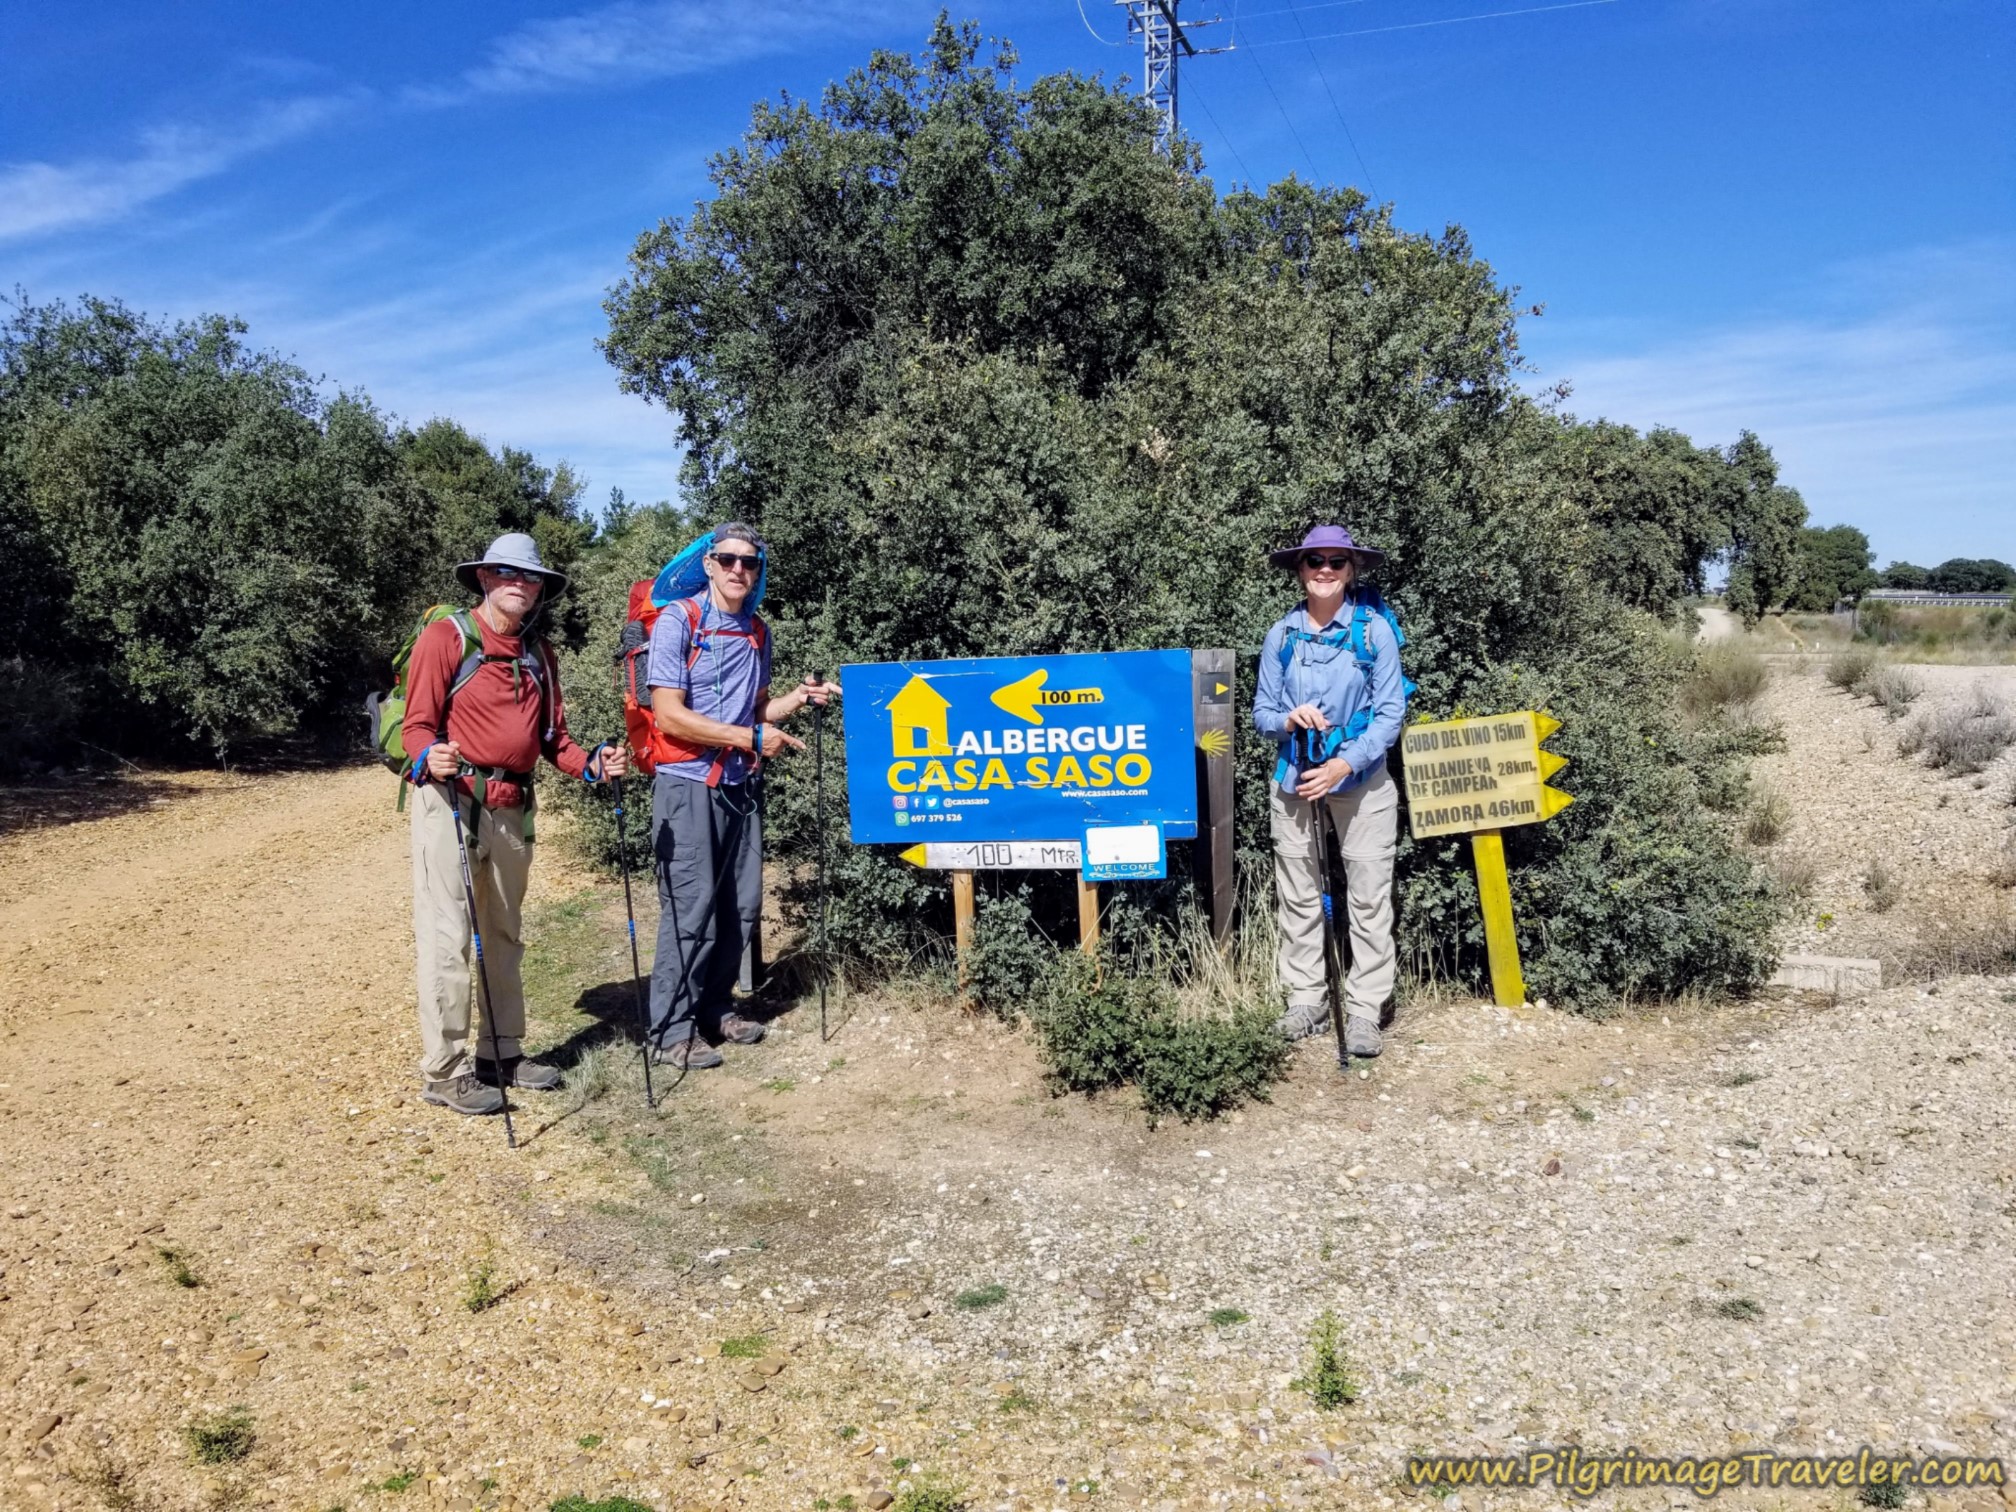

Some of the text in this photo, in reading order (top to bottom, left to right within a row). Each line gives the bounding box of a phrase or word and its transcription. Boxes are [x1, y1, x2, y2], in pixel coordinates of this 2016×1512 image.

[1041, 690, 1102, 704] 100 m.
[956, 724, 1147, 756] ALBERGUE
[1405, 723, 1526, 754] CUBO DEL VINO 15km
[887, 752, 1153, 793] CASA SASO
[1409, 757, 1492, 783] VILLANUEVA
[1061, 789, 1149, 798] www.casasaso.com
[1410, 775, 1498, 799] DE CAMPEAN
[943, 797, 990, 808] @casasaso
[1415, 800, 1536, 828] ZAMORA 46km
[911, 813, 963, 823] 697 379 526
[967, 843, 1012, 867] 100
[1093, 863, 1155, 873] WELCOME
